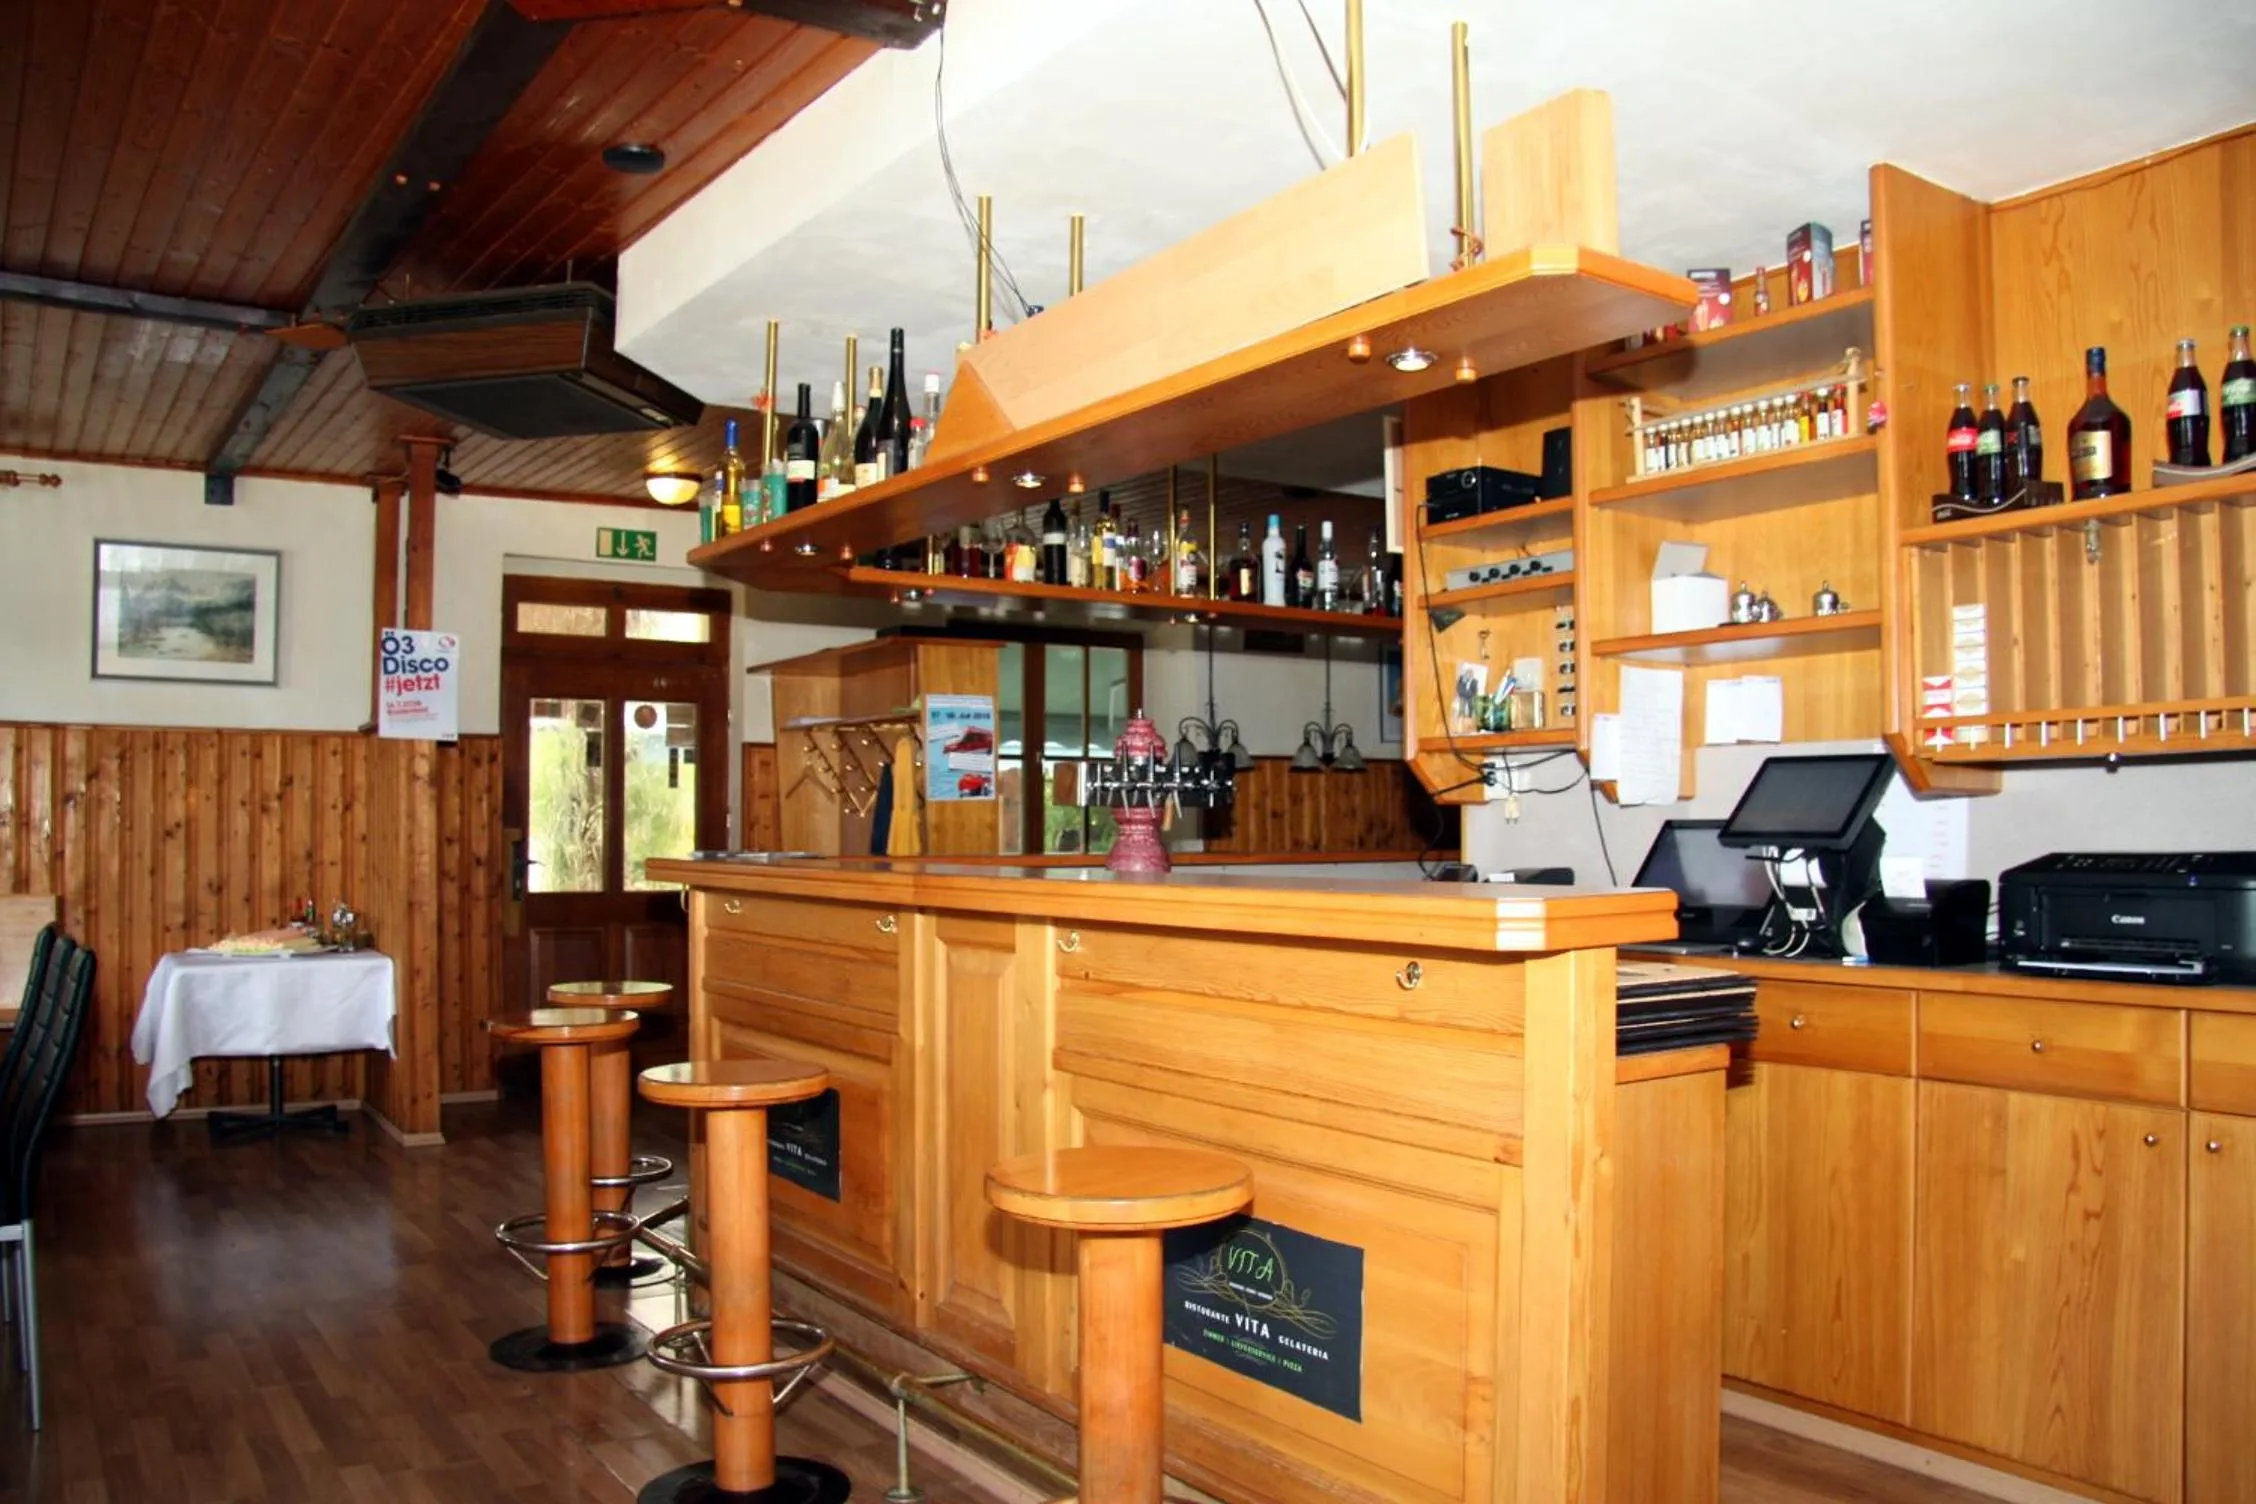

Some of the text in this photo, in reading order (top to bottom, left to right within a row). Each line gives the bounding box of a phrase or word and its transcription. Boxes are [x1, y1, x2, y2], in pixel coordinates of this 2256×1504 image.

[381, 631, 415, 655] Ö3
[383, 655, 449, 675] Disco
[385, 673, 440, 696] #jetzt
[2111, 914, 2145, 924] Canon
[1228, 1245, 1273, 1282] VITA
[1184, 1300, 1230, 1324] RISTORANTE
[1235, 1313, 1270, 1339] VITA
[1278, 1335, 1329, 1360] GELATERIA
